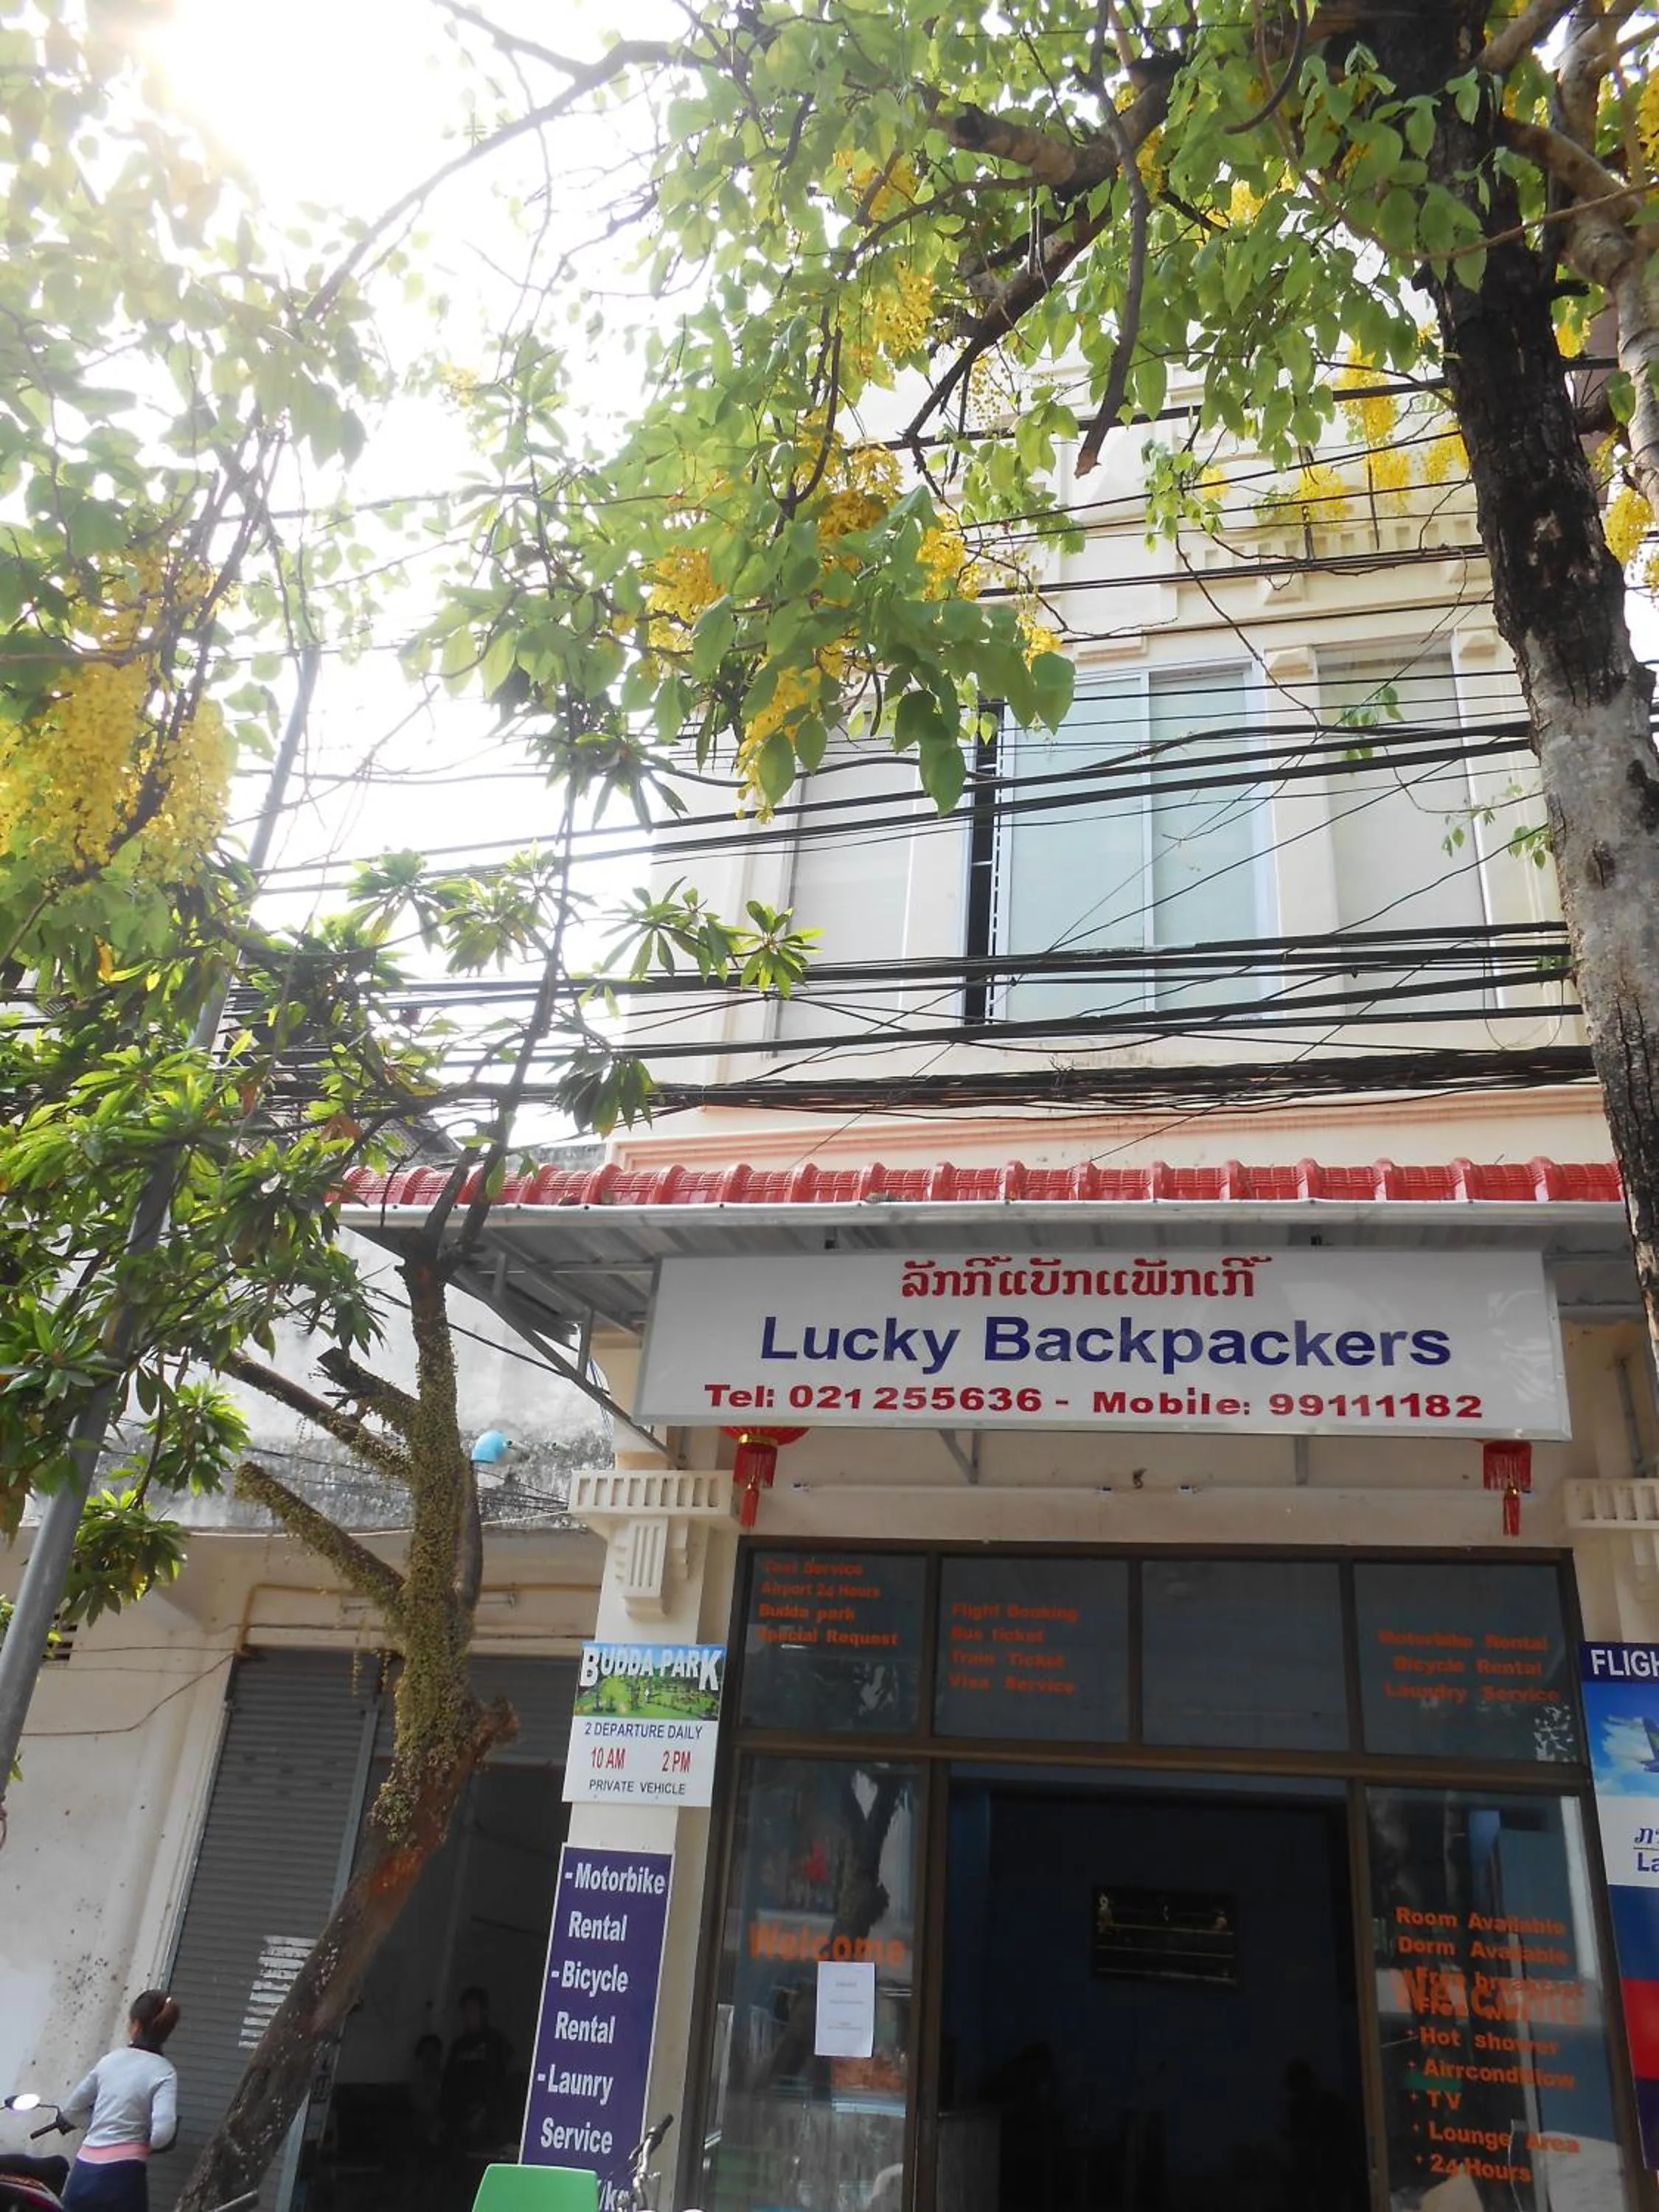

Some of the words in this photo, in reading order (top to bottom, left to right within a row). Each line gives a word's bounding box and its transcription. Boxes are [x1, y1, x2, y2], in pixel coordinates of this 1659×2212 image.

[761, 1315, 960, 1374] Lucky
[984, 1317, 1453, 1377] Backpackers
[705, 1384, 775, 1408] Tel:
[1093, 1388, 1251, 1416] Mobile:
[1269, 1392, 1483, 1419] 99111182
[826, 1629, 899, 1648] Request
[580, 1647, 654, 1686] BUDDA
[660, 1649, 722, 1690] PARK
[1475, 1658, 1542, 1676] Rental
[1480, 1685, 1560, 1704] Service
[585, 1722, 593, 1736] 2
[594, 1722, 665, 1738] DEPARTURE
[667, 1725, 703, 1739] DAILY
[591, 1747, 602, 1768] 10
[606, 1748, 626, 1770] AM
[662, 1751, 670, 1771] 2
[672, 1751, 691, 1773] PM
[589, 1781, 634, 1792] PRIVATE
[639, 1782, 685, 1795] VEHICLE
[568, 1911, 627, 1942] Rental
[1395, 1906, 1457, 1927] Room
[1468, 1912, 1567, 1935] Available
[747, 1919, 907, 1967] Welcome
[1397, 1935, 1455, 1955] Dorm
[1470, 1941, 1568, 1966] Available
[554, 2011, 616, 2044] Rental
[1419, 2026, 1461, 2047] Hot
[1475, 2032, 1559, 2055] shower
[1426, 2089, 1462, 2111] TV
[541, 2118, 613, 2154] Service
[1427, 2121, 1512, 2151] Lounge
